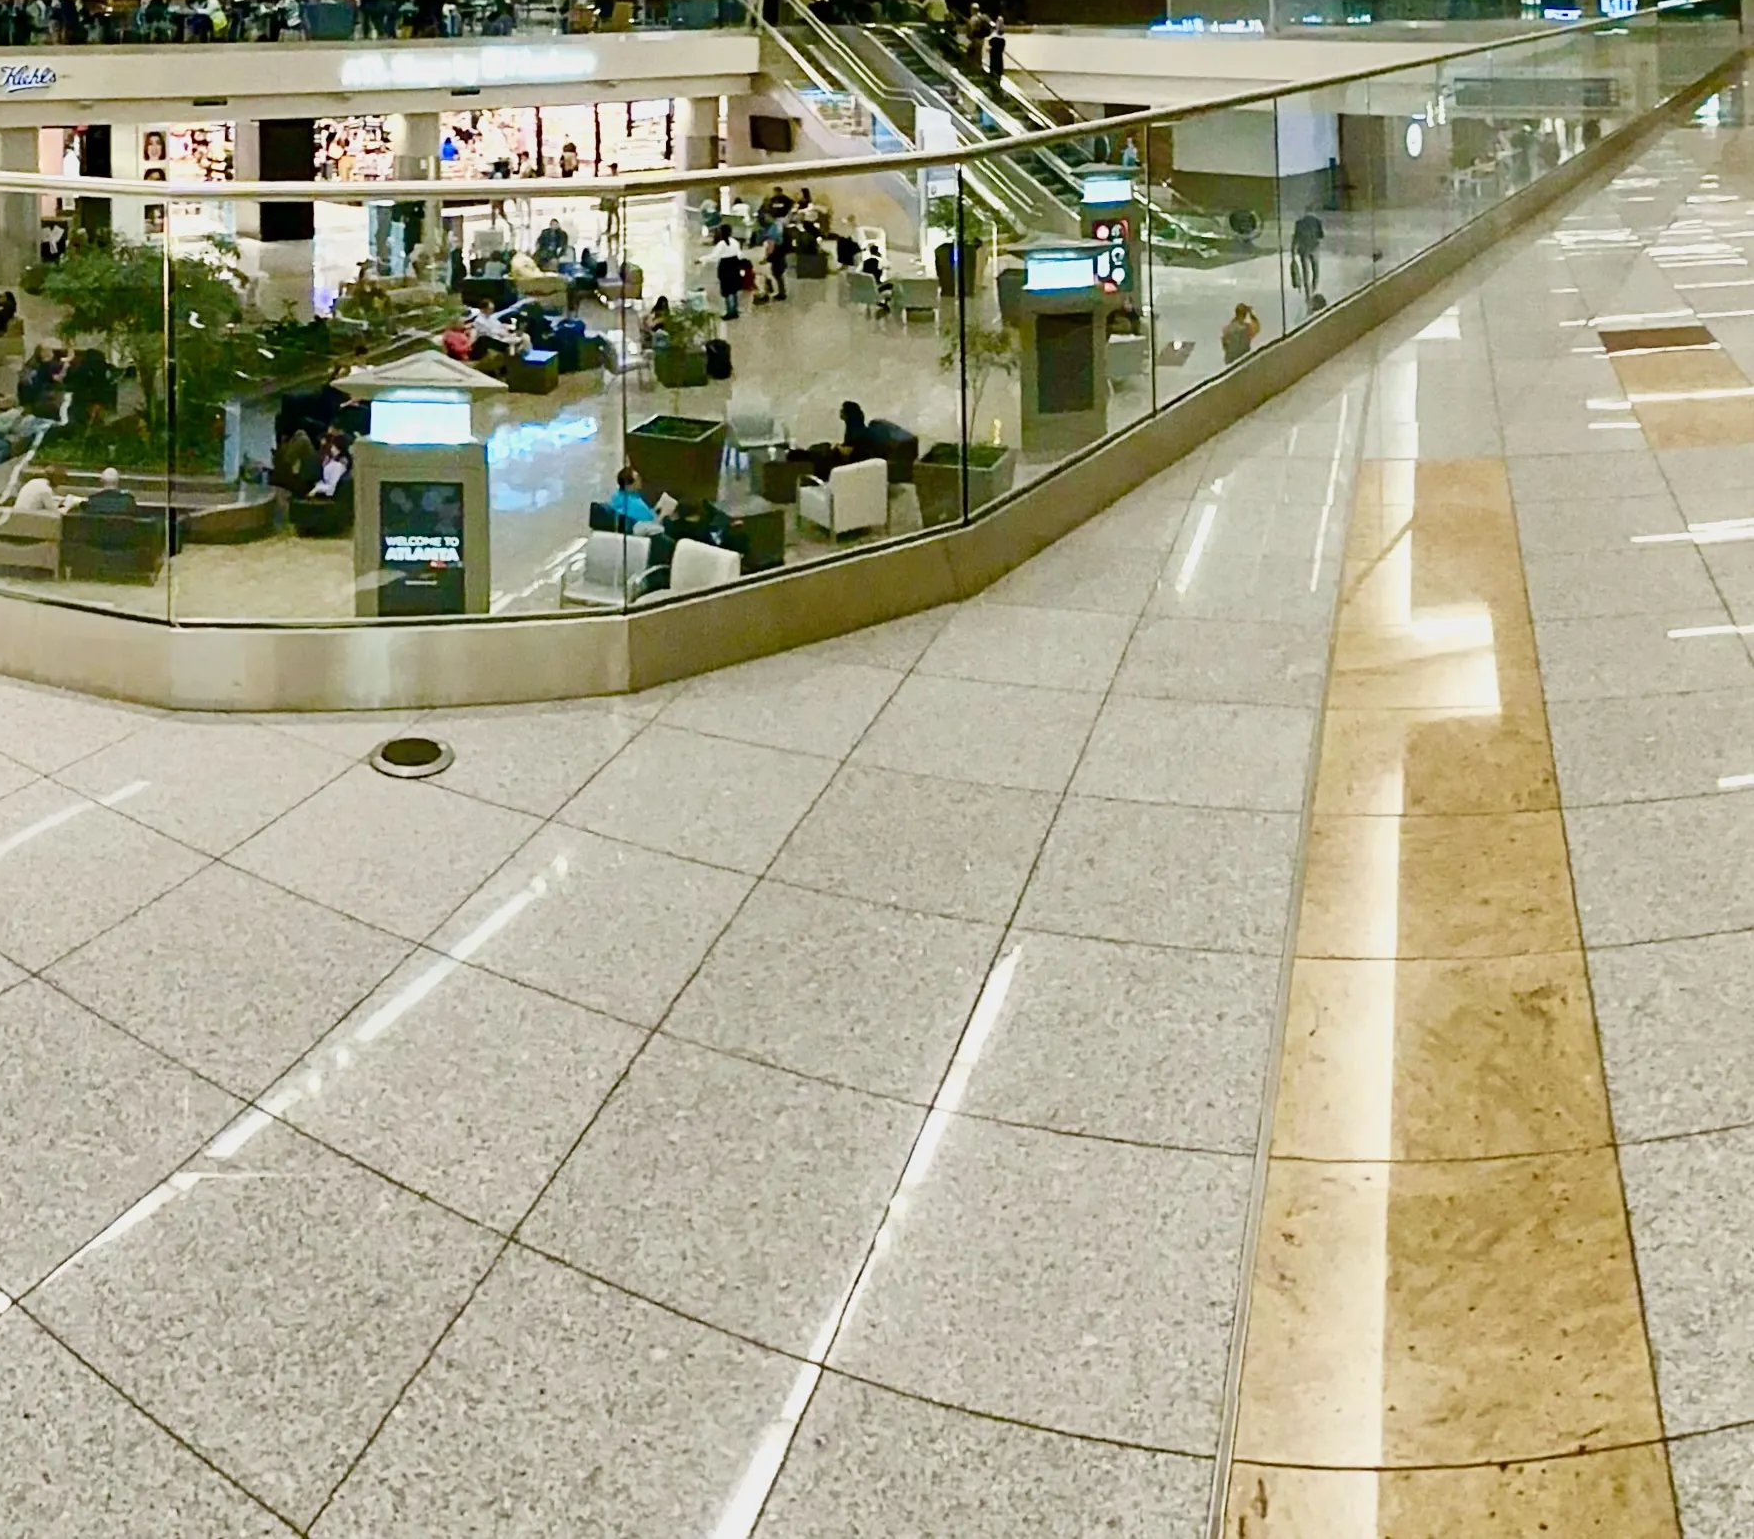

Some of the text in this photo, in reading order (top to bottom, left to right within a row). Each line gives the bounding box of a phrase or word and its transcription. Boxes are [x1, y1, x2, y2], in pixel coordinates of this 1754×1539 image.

[384, 535, 460, 547] WELCOME TO
[384, 546, 461, 561] ATLANTA
